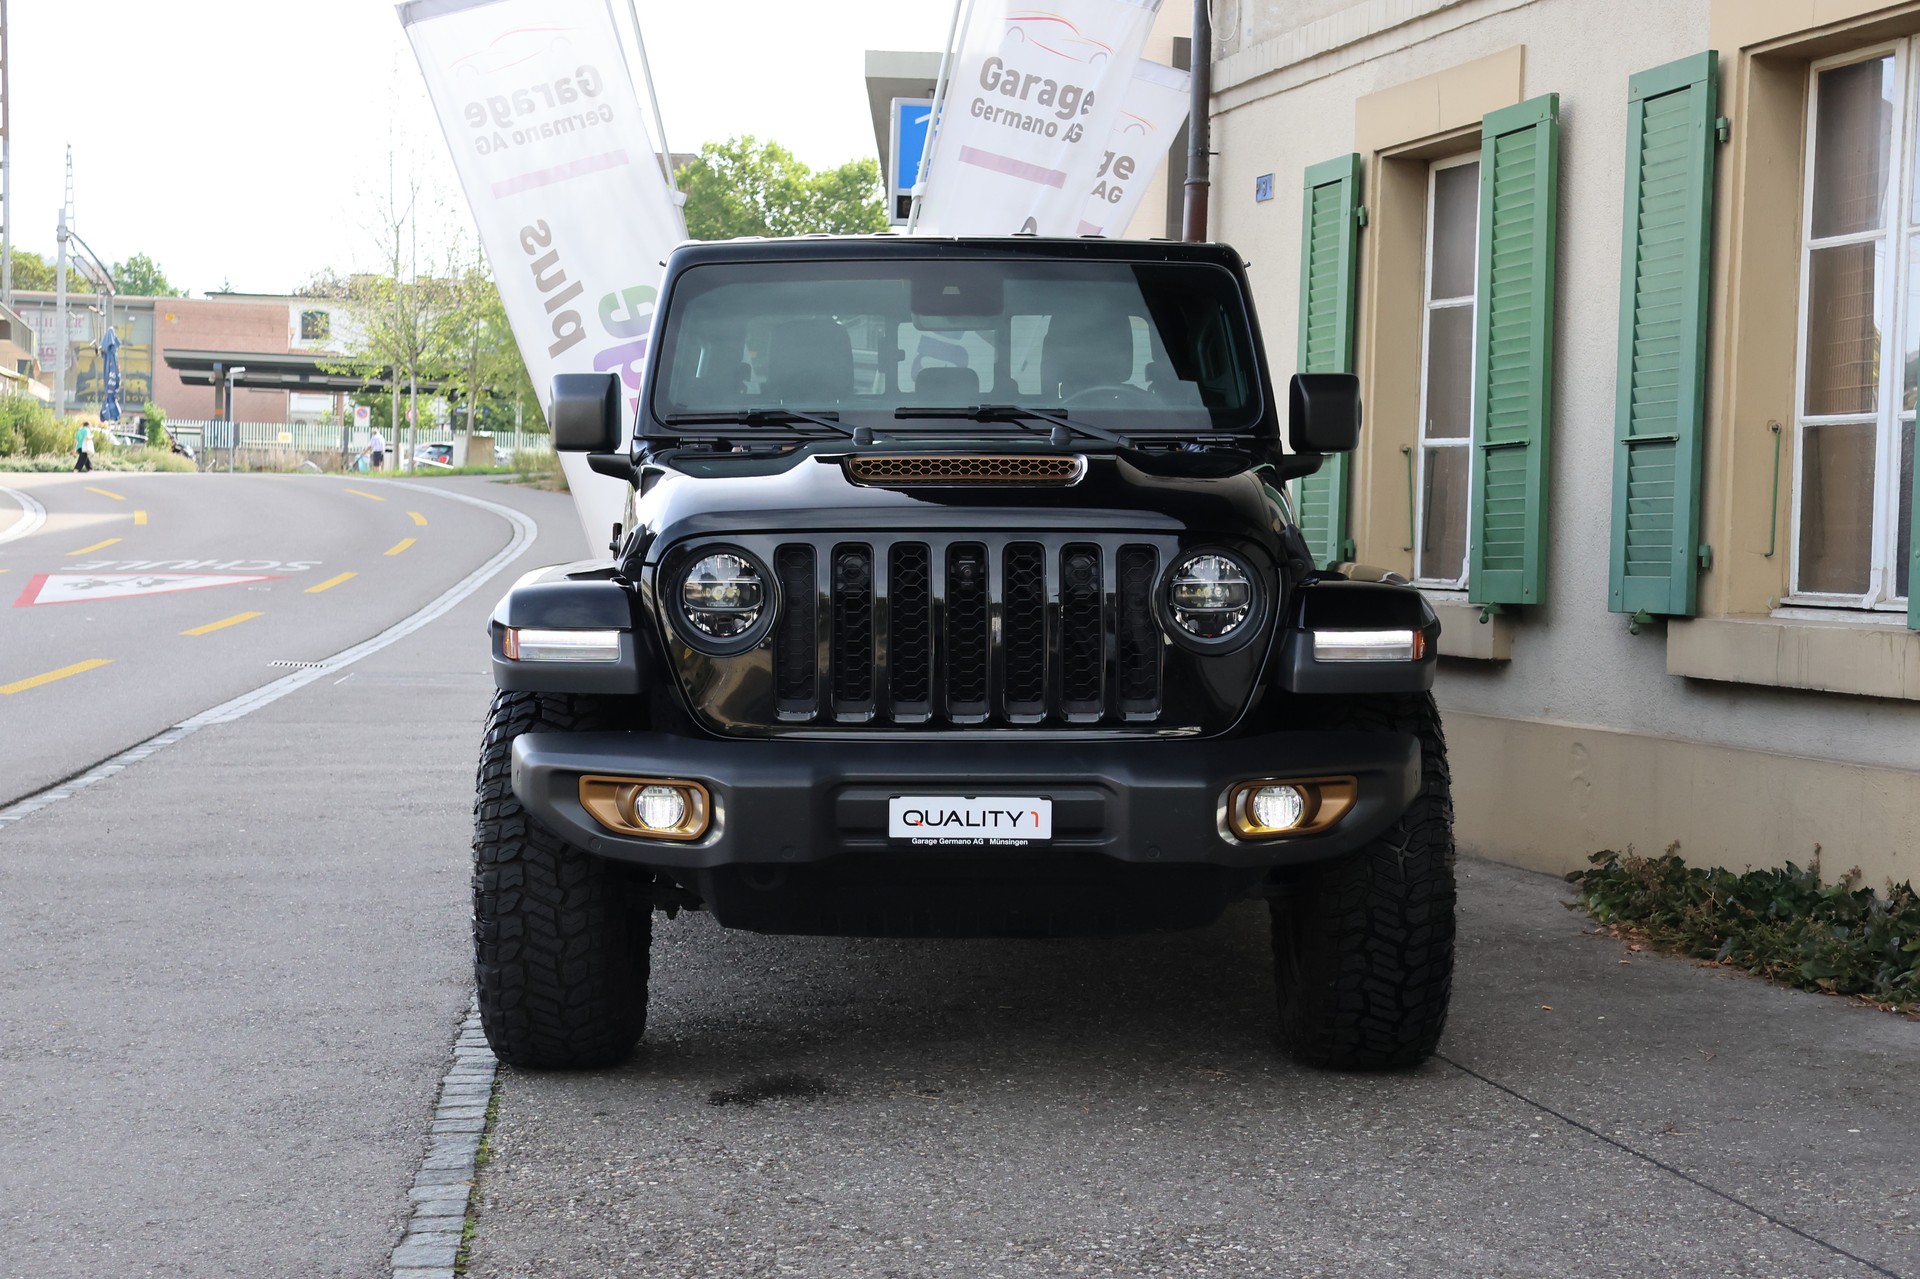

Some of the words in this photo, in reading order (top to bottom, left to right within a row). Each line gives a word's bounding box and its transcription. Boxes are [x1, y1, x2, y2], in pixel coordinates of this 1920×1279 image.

[979, 56, 1095, 120] Garage
[970, 97, 1058, 138] Germano
[1090, 180, 1124, 204] AG
[61, 560, 323, 571] SCHULE
[902, 809, 1024, 828] QUALITY
[1030, 811, 1039, 828] 1
[911, 837, 938, 846] Garage
[939, 837, 971, 846] Germano
[989, 837, 1028, 846] Münsingen
